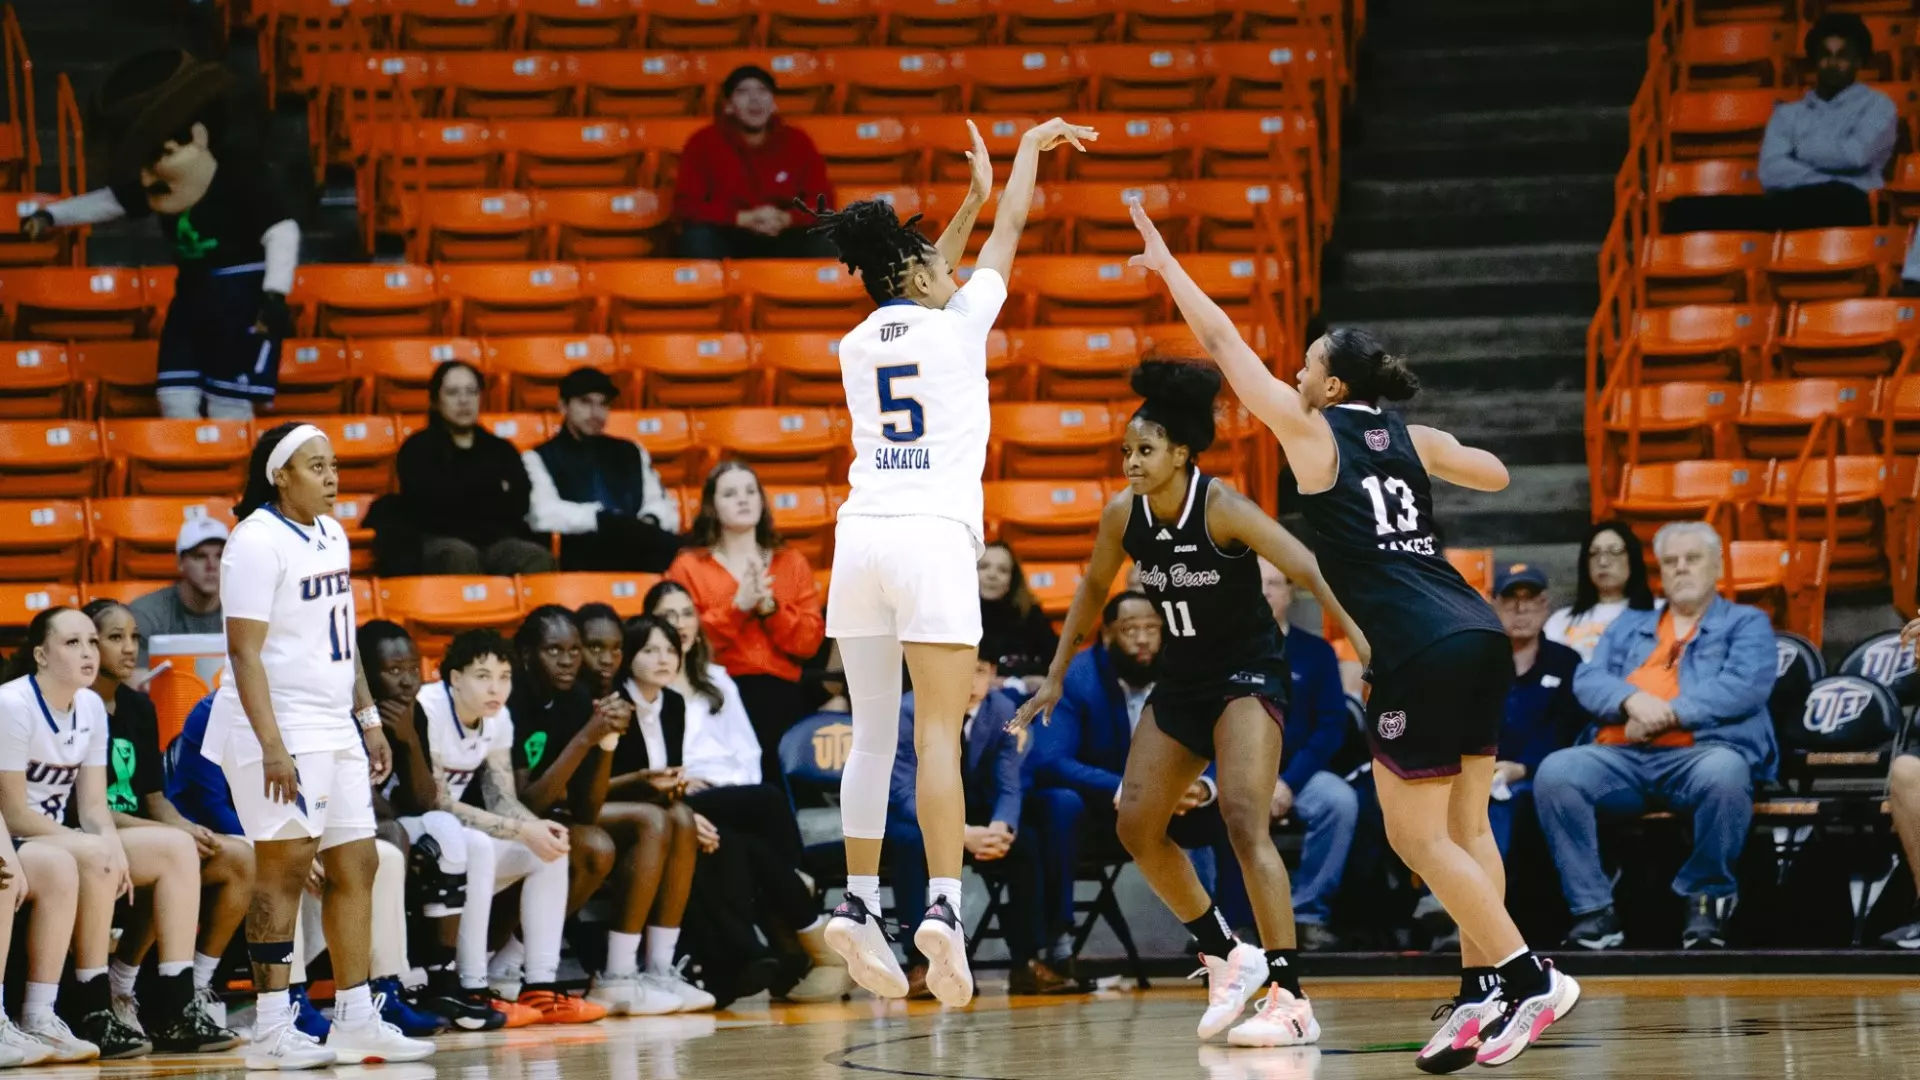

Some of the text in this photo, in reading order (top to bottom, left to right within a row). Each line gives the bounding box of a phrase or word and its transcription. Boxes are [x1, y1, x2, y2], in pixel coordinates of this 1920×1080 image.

[880, 321, 909, 343] UTEP
[875, 361, 926, 445] 5
[875, 447, 930, 470] SAMAYOA
[1361, 475, 1419, 535] 13
[1377, 536, 1435, 555] MES
[299, 568, 350, 601] UTE
[1138, 561, 1221, 592] ady Bears
[328, 603, 351, 662] 11
[1161, 600, 1196, 637] 11
[1861, 638, 1917, 687] UTE
[1804, 682, 1873, 733] UTEP
[26, 760, 81, 785] UTE
